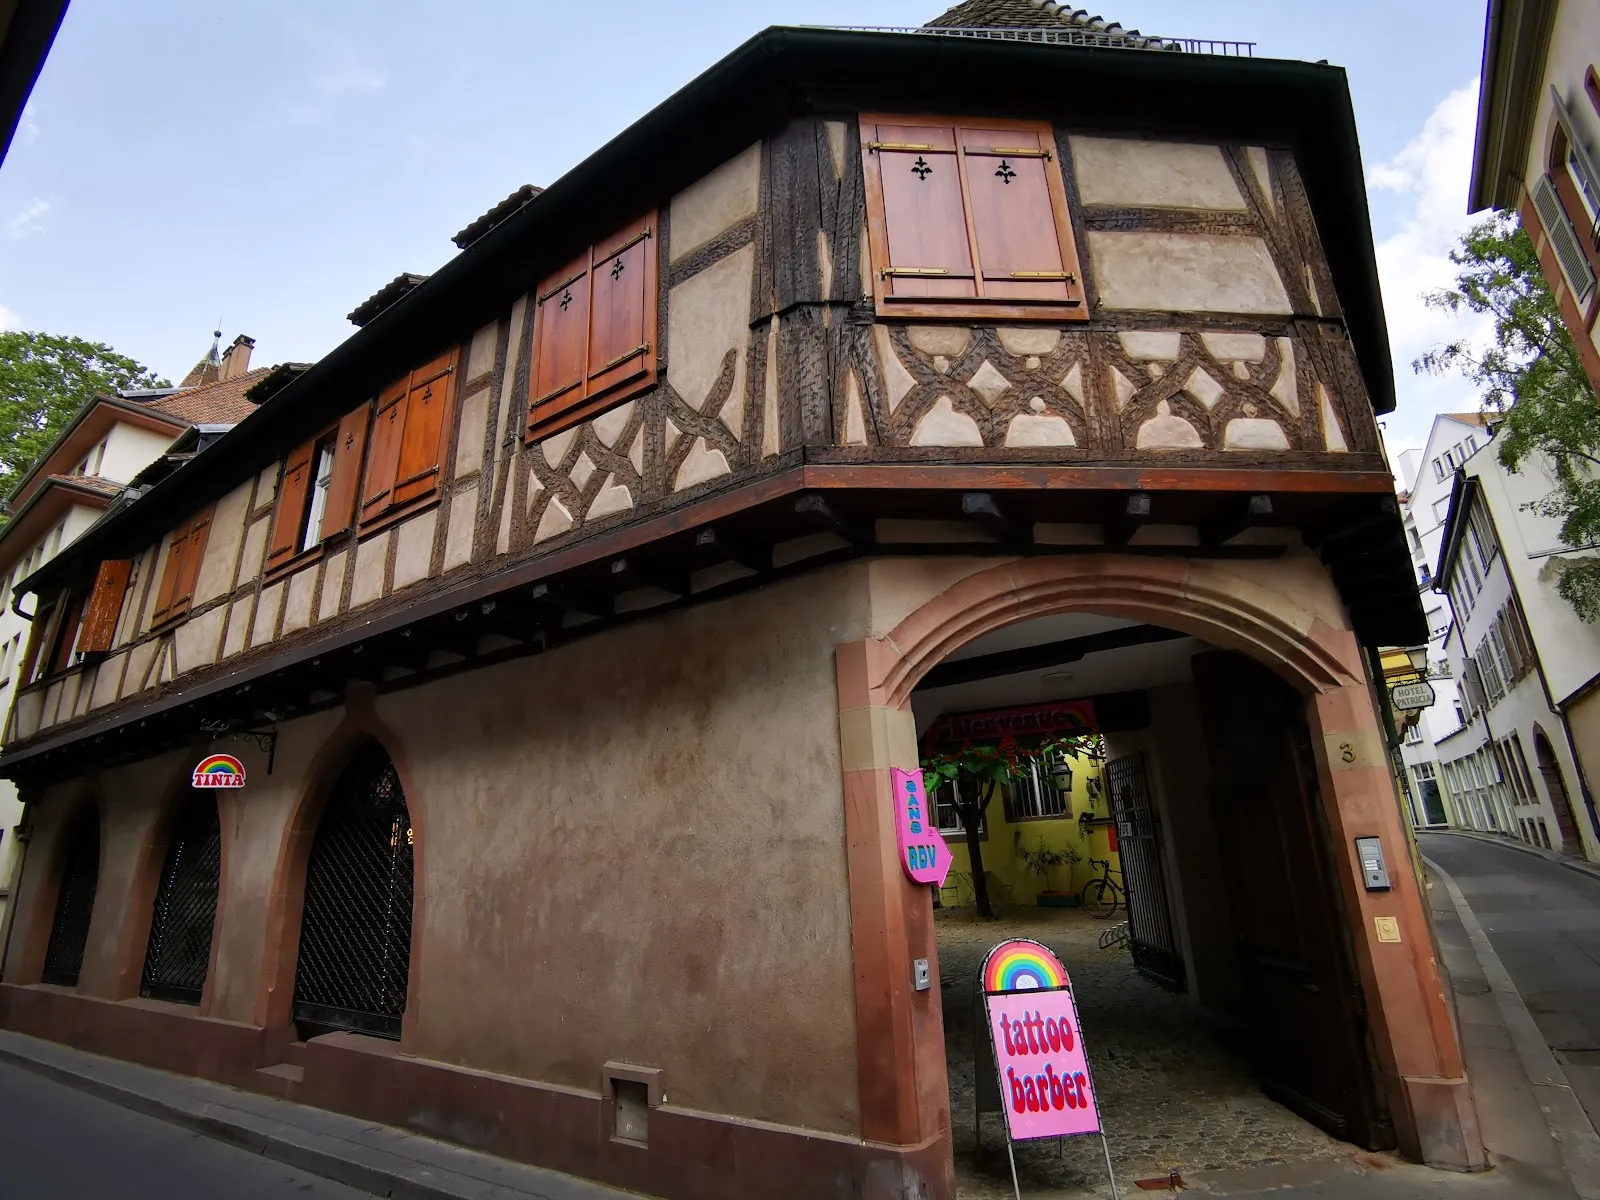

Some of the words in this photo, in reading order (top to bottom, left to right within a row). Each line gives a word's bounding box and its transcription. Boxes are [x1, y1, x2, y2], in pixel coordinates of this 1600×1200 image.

[1397, 687, 1427, 698] HOTEL
[1397, 694, 1432, 707] PATRICIA
[1339, 743, 1357, 763] 3
[194, 773, 244, 787] TINTA
[905, 780, 922, 835] SANS
[907, 844, 936, 871] RDV
[999, 1009, 1074, 1057] tattoo
[1005, 1062, 1089, 1115] barber
